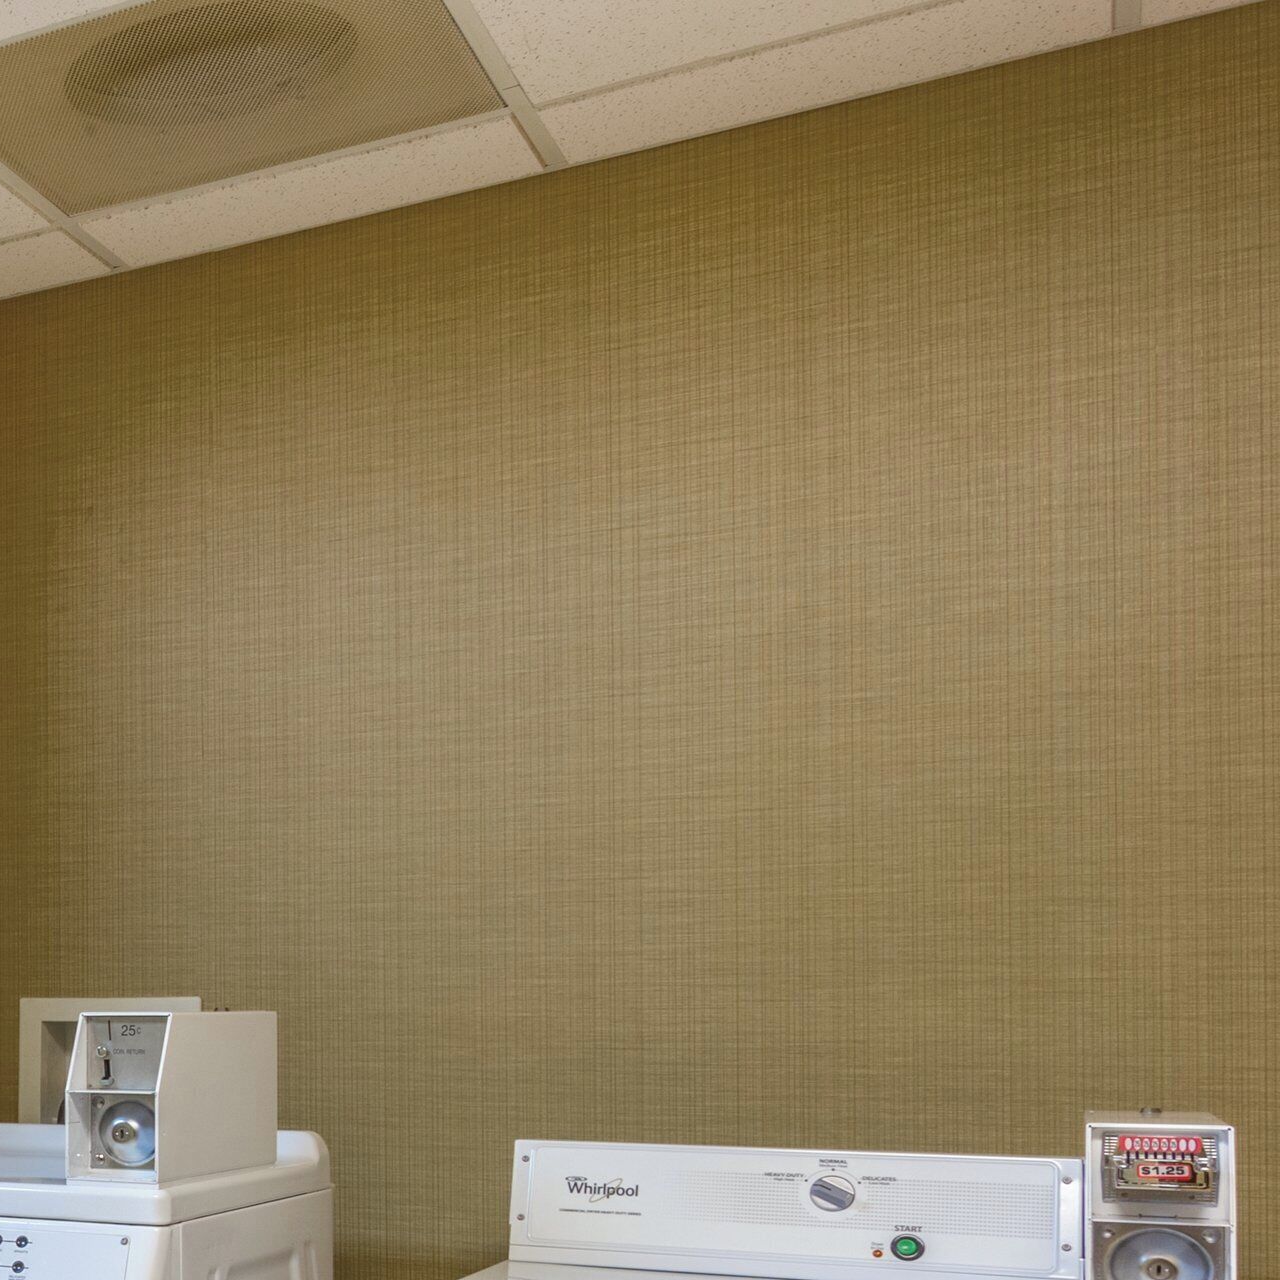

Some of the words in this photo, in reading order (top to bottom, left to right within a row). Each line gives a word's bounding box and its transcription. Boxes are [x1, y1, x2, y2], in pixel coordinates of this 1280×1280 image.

[1141, 1166, 1185, 1176] $1.25
[567, 1181, 639, 1199] Whirlpool
[894, 1224, 923, 1233] START
